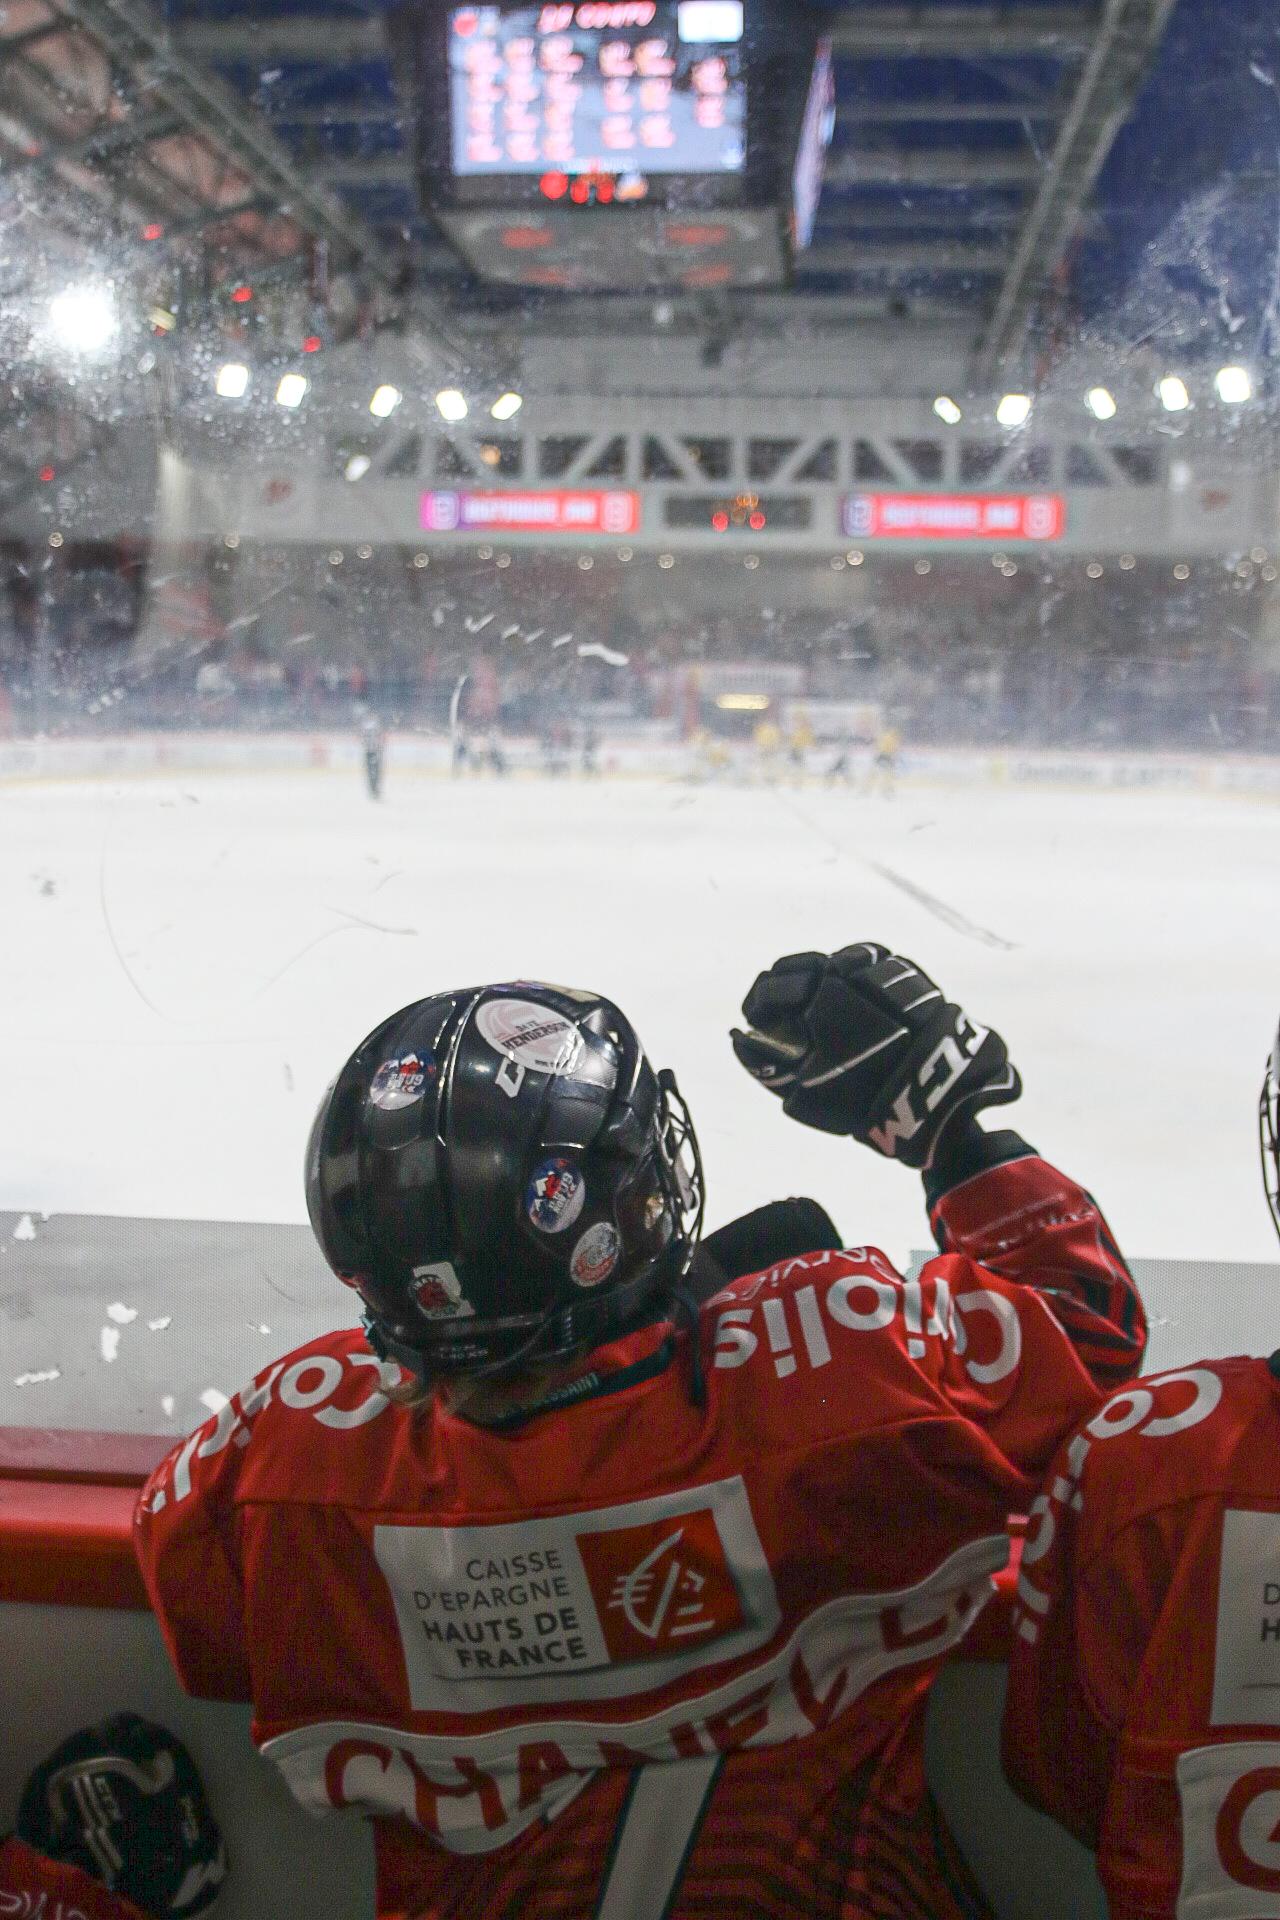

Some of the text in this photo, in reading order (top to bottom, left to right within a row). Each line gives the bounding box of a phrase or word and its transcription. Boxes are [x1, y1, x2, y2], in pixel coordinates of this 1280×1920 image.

[501, 1021, 571, 1050] HENDERSON
[714, 1275, 1021, 1384] Criolis
[466, 1550, 562, 1581] CAISSE
[414, 1576, 569, 1612] D'EPARGNE
[423, 1608, 579, 1645] HAUTS DE
[457, 1637, 588, 1670] FRANCE
